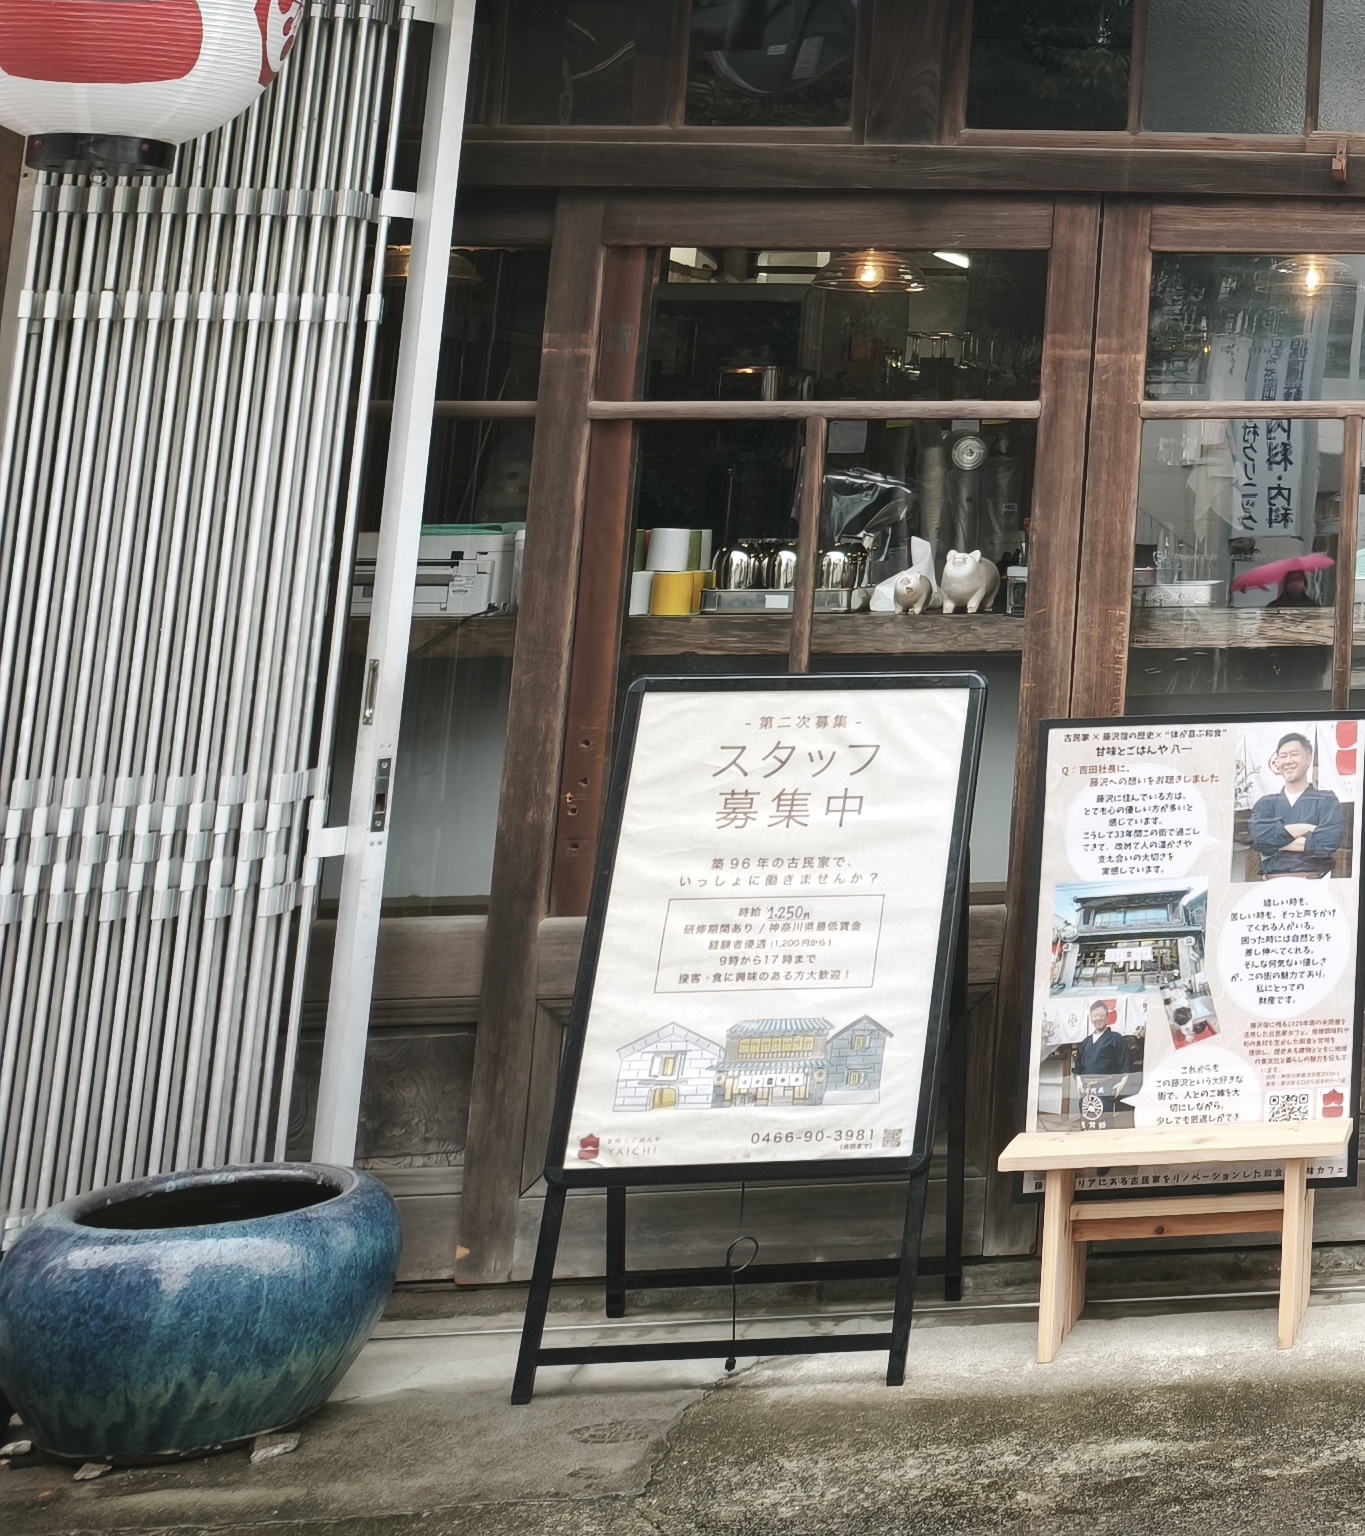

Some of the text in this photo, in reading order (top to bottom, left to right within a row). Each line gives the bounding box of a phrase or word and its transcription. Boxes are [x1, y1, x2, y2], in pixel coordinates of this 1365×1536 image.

[759, 715, 847, 730] 第二次募集
[1095, 744, 1193, 757] 甘味とごはんや 八一
[712, 740, 881, 779] スタッフ
[715, 787, 864, 830] 募集中
[738, 907, 761, 918] 時給
[683, 922, 753, 935] 研修期間あり
[768, 920, 862, 934] 神奈川県最低賃金
[708, 939, 766, 951] 経験者優遇
[750, 1128, 875, 1145] 0466-90-3981
[607, 1146, 657, 1157] YAICHI
